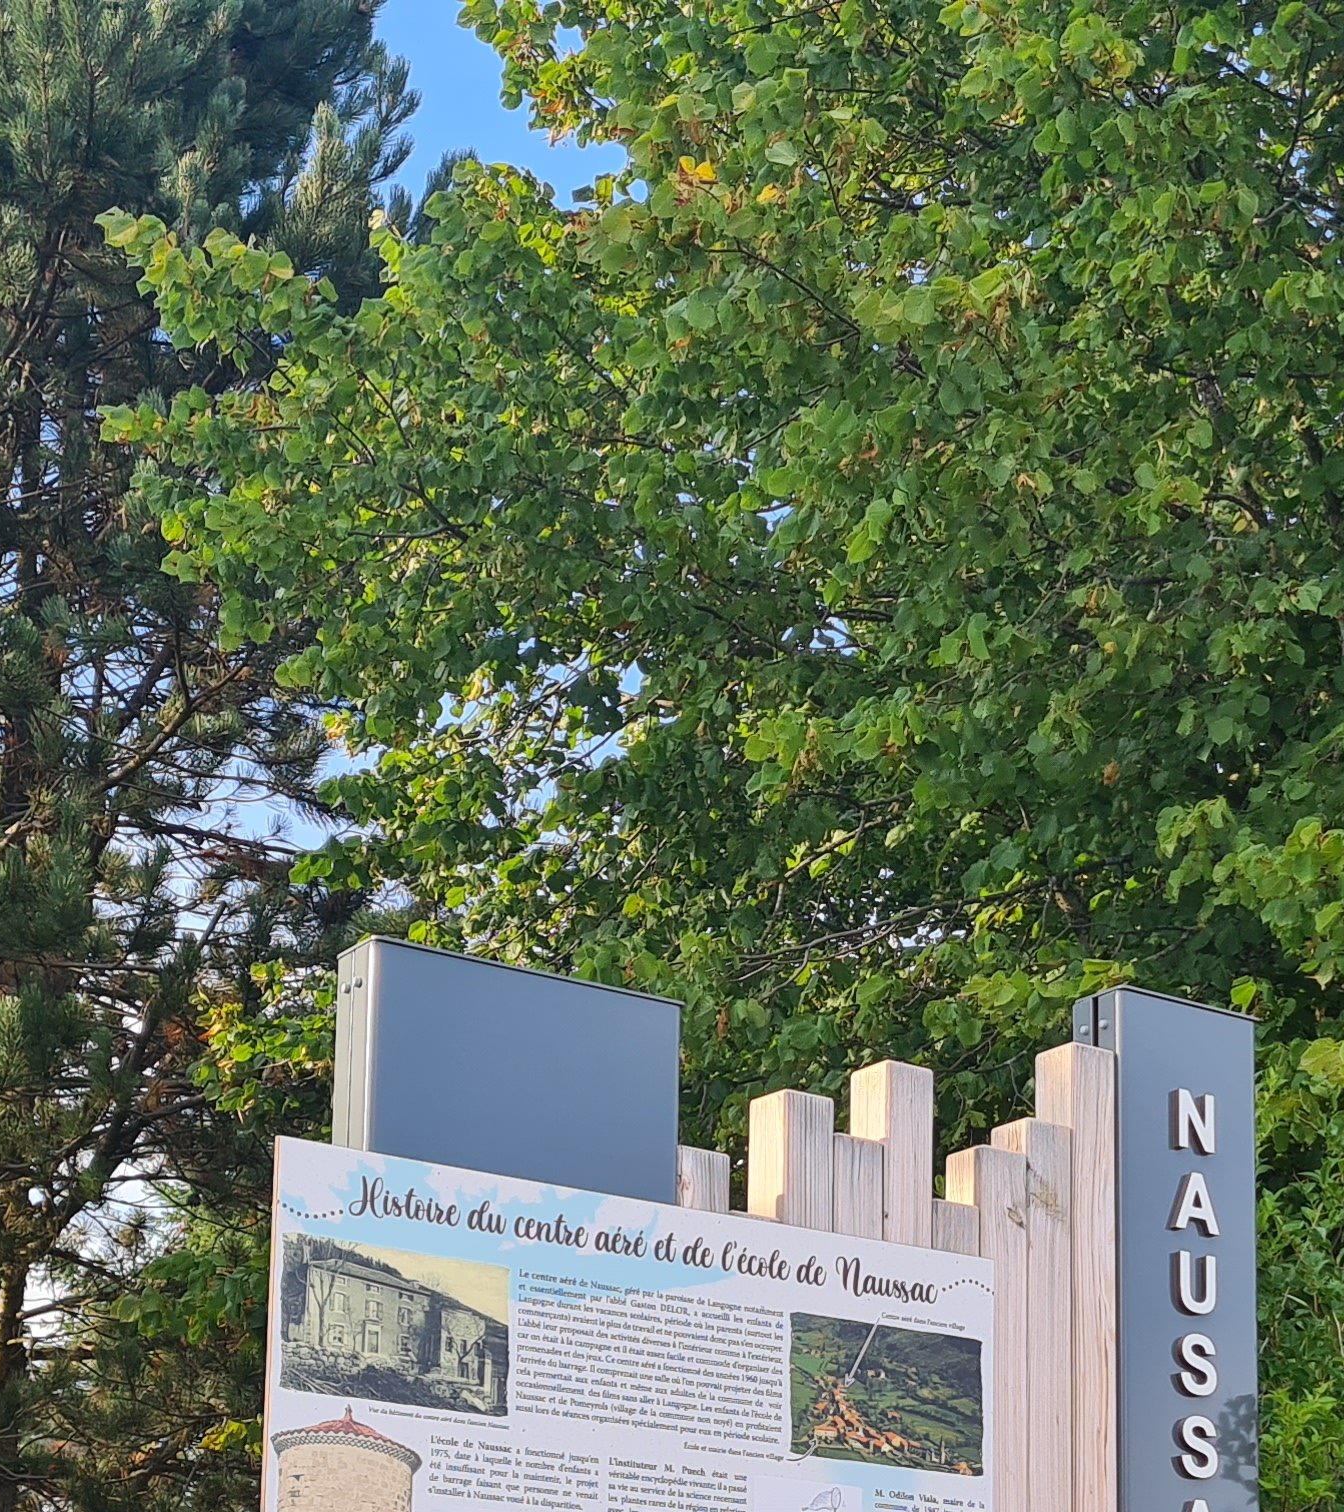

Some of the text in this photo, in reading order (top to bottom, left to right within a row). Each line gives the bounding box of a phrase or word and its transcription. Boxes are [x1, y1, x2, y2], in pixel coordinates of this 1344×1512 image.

[348, 1175, 938, 1304] Histoire du centre aéré et de l'école de Naussac
